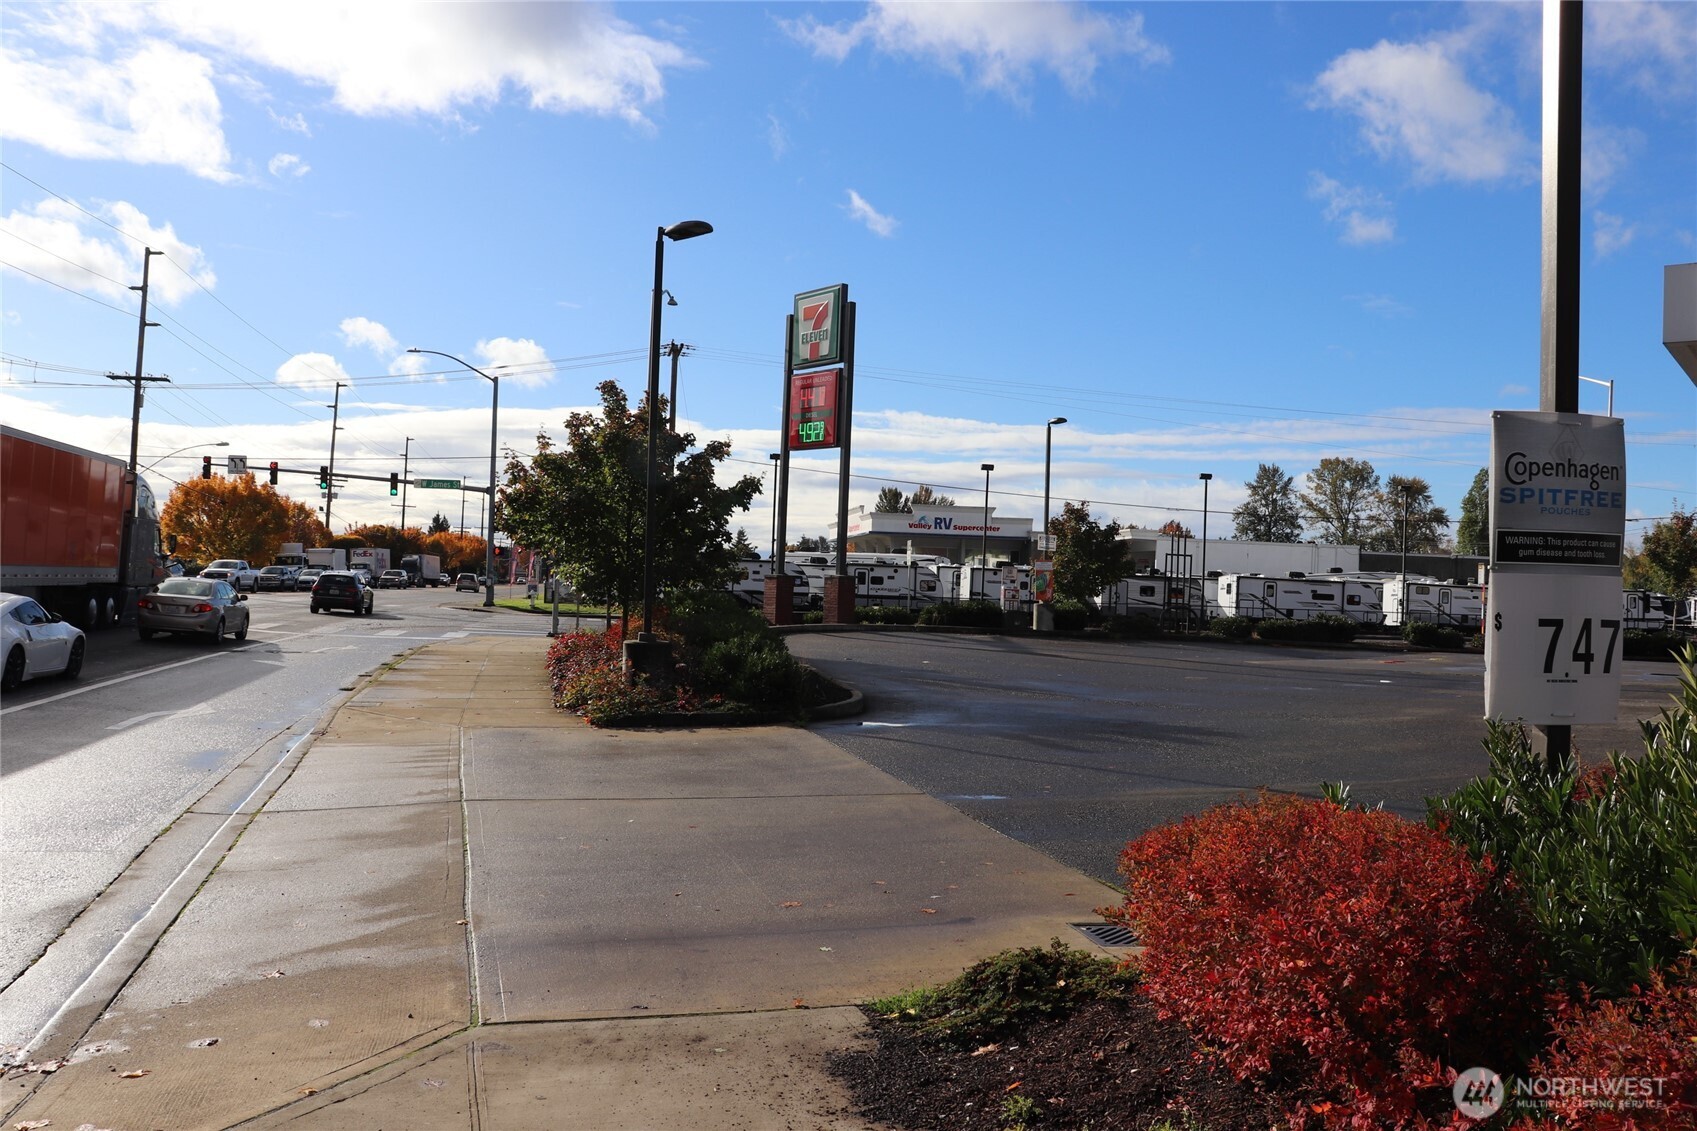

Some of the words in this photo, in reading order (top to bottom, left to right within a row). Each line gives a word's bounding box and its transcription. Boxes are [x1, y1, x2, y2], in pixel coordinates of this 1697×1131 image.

[802, 300, 829, 361] 7
[1504, 452, 1619, 491] Copenhagen
[421, 480, 428, 488] W
[430, 480, 451, 489] James
[453, 481, 460, 489] St
[1499, 487, 1623, 508] SPITFREE
[1540, 506, 1591, 516] POUCHES
[908, 522, 932, 530] Valley
[934, 517, 953, 530] RV
[1505, 536, 1546, 545] WARNING:
[1547, 537, 1561, 546] This
[1562, 538, 1587, 548] product
[352, 550, 373, 558] FedEx
[1518, 549, 1534, 557] gum
[1536, 548, 1562, 557] disease
[1564, 549, 1576, 557] and
[1577, 549, 1593, 558] tooth
[1593, 550, 1606, 559] loss.
[1494, 612, 1502, 632] $
[1538, 618, 1620, 678] 7.47
